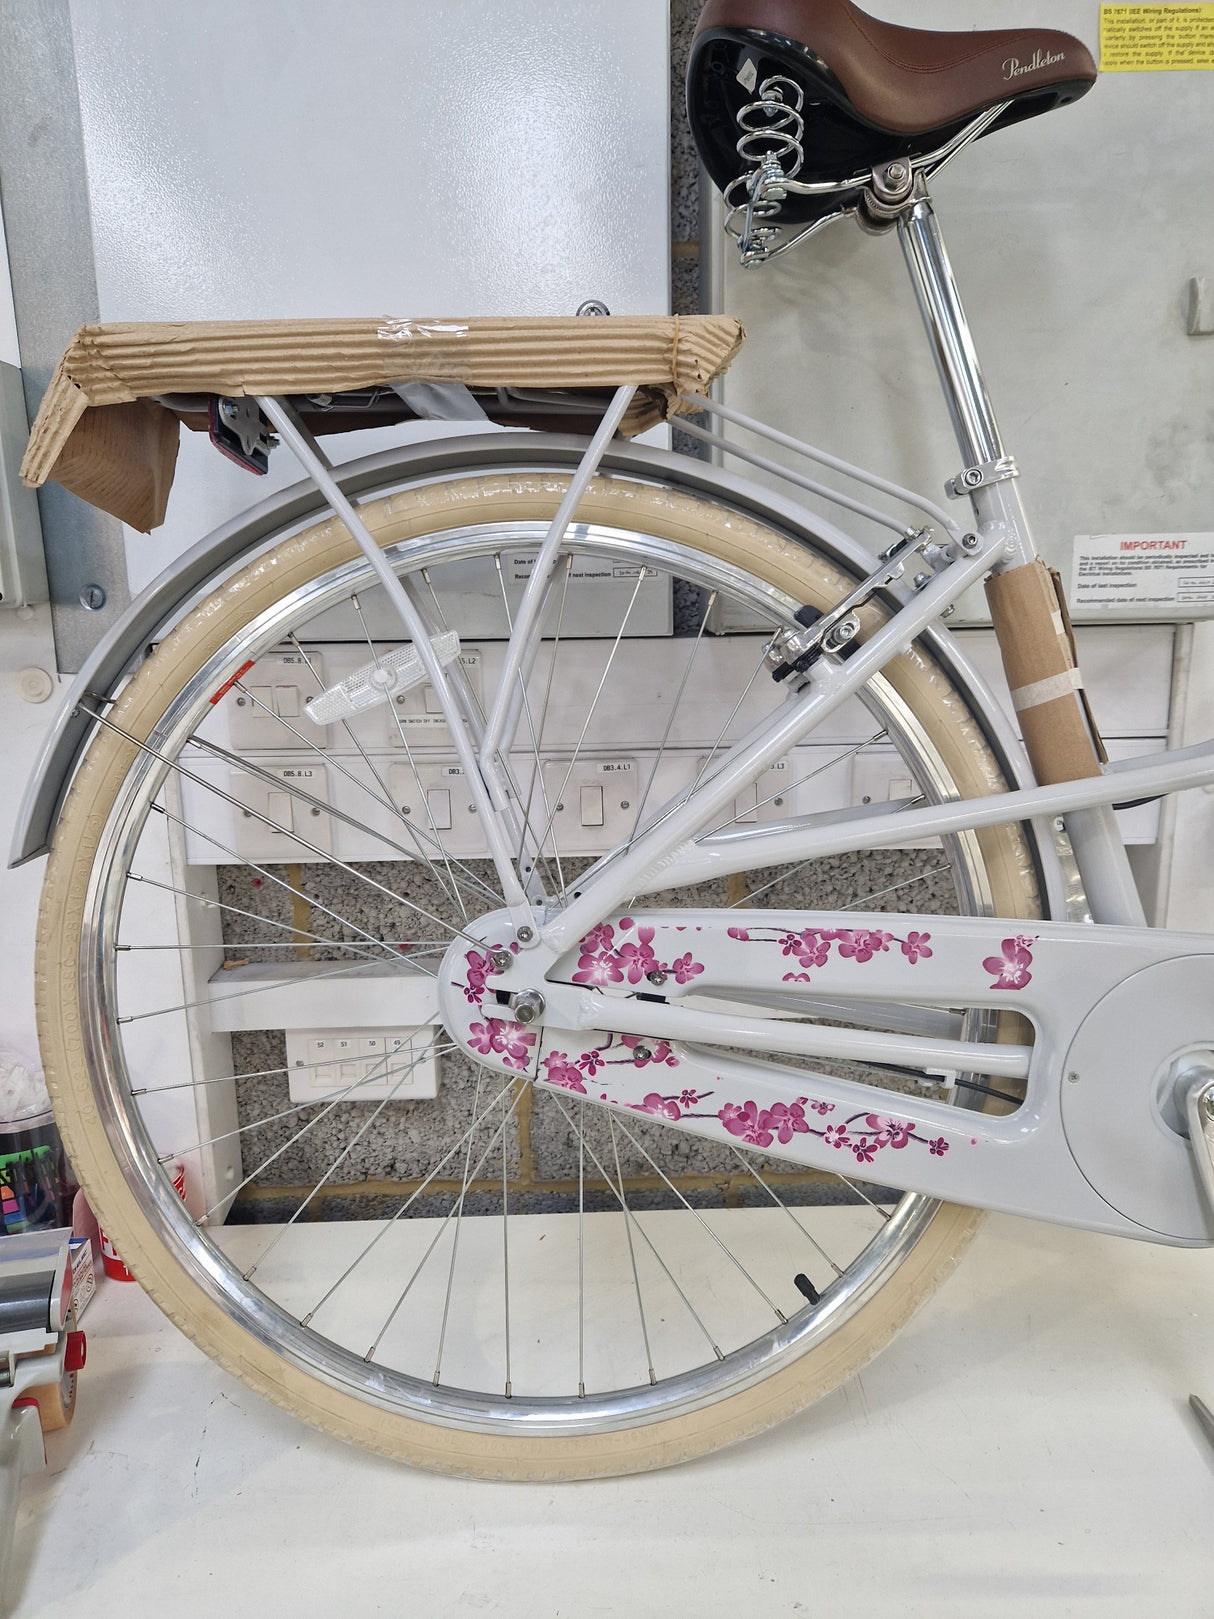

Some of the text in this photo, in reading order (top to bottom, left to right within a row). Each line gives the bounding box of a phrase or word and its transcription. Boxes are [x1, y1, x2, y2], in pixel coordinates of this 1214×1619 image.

[1001, 48, 1065, 80] Pendleton
[1120, 540, 1187, 551] IMPORTANT
[603, 763, 631, 772] DB3.4.L1
